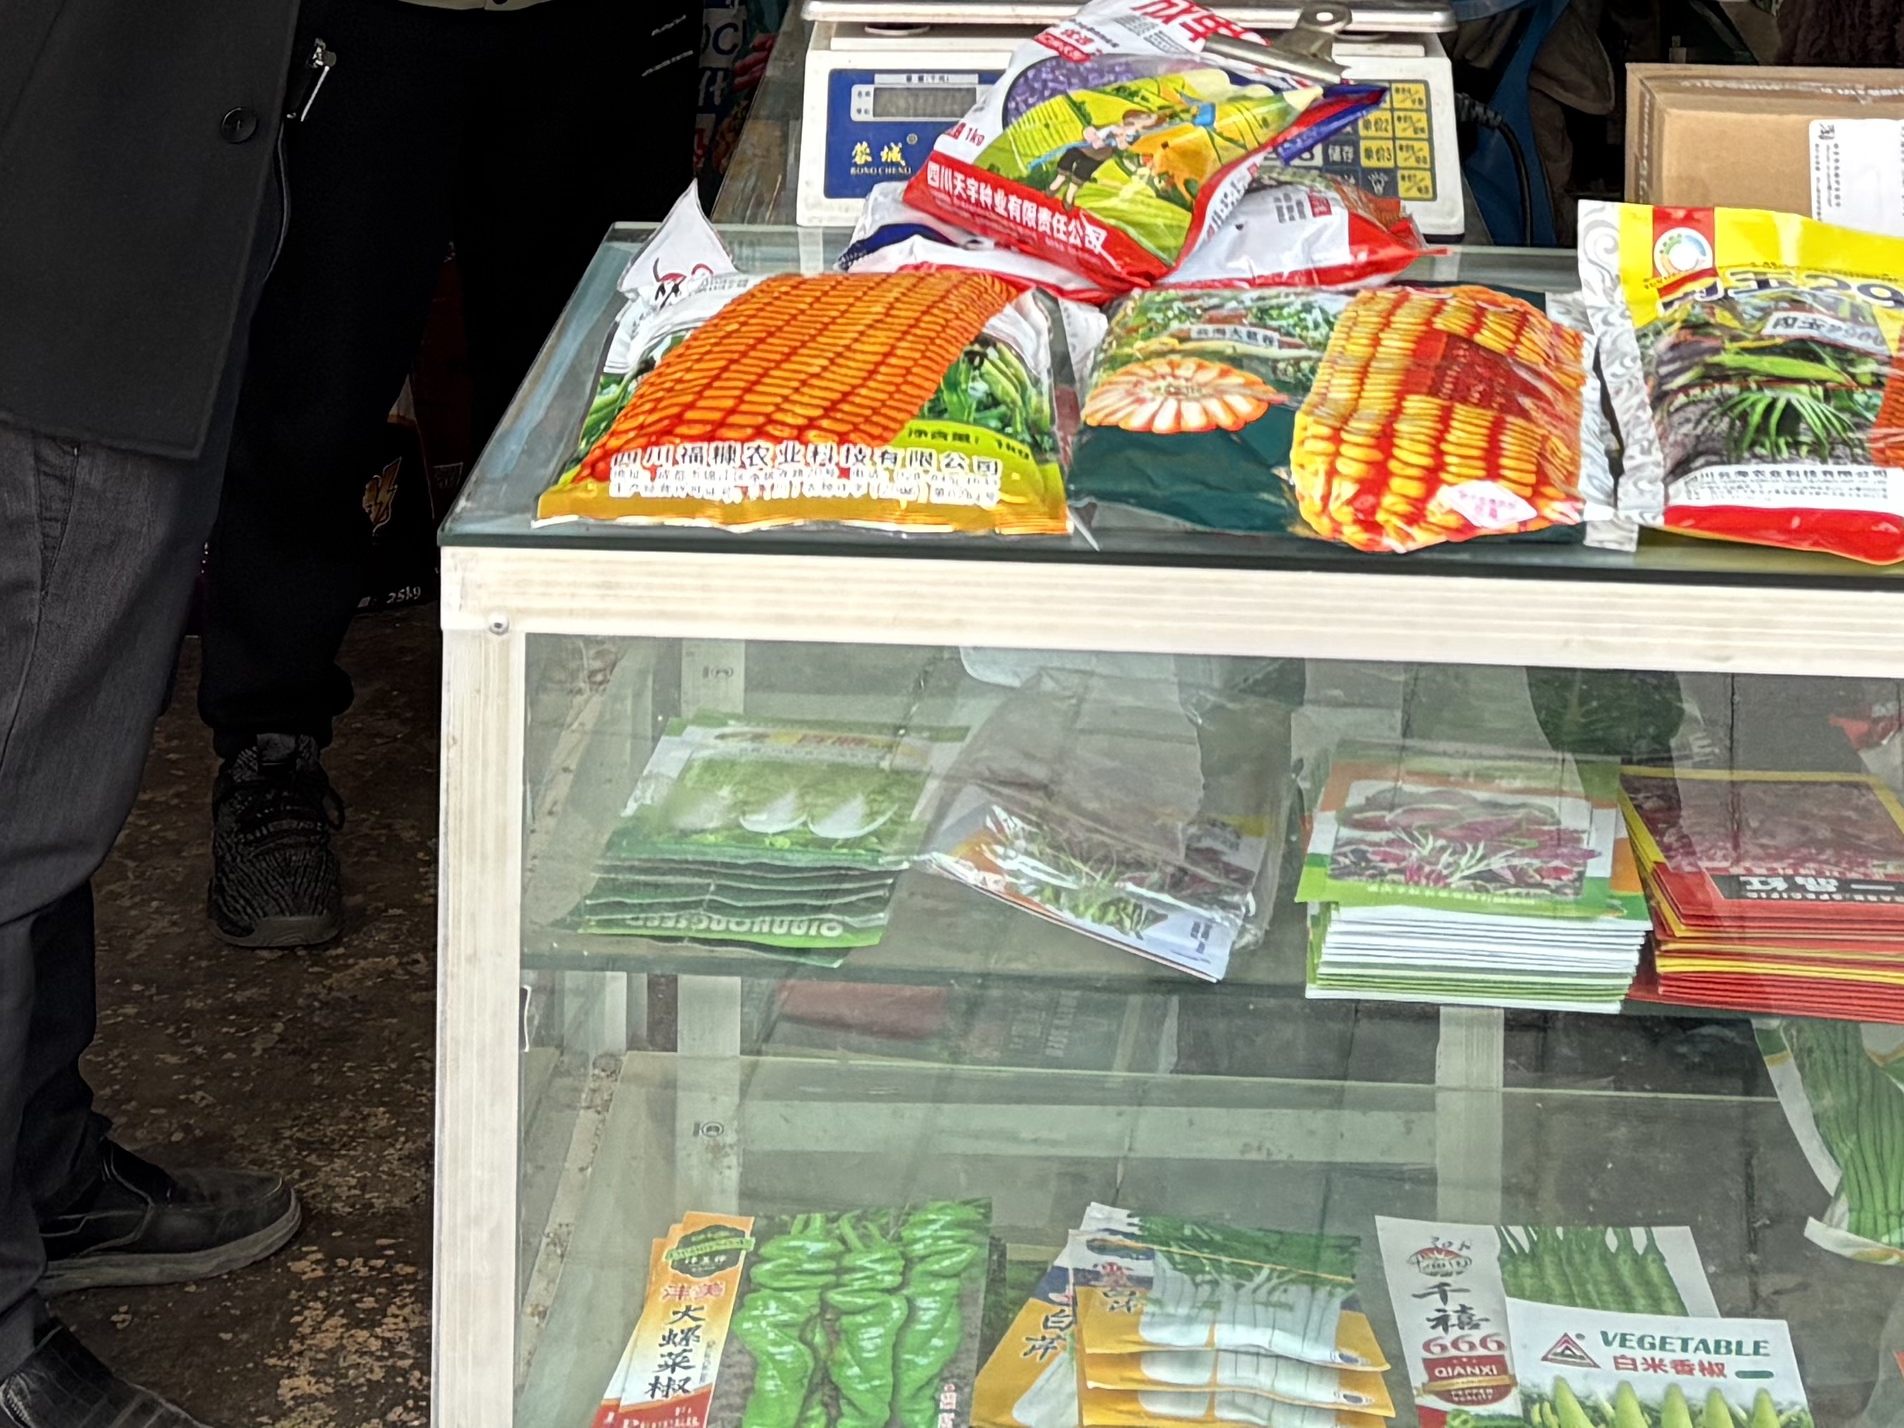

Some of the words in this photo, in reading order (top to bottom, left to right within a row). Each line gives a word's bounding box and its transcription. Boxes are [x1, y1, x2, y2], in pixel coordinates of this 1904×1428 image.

[964, 128, 986, 147] 1kg
[851, 140, 907, 166] 蓉城
[1327, 146, 1355, 163] 储存
[1411, 1281, 1492, 1333] 千禧
[1420, 1333, 1508, 1356] 666
[1598, 1329, 1773, 1358] VEGETABLE
[1434, 1363, 1497, 1379] QIANXI
[1611, 1354, 1729, 1382] 白米香椒
